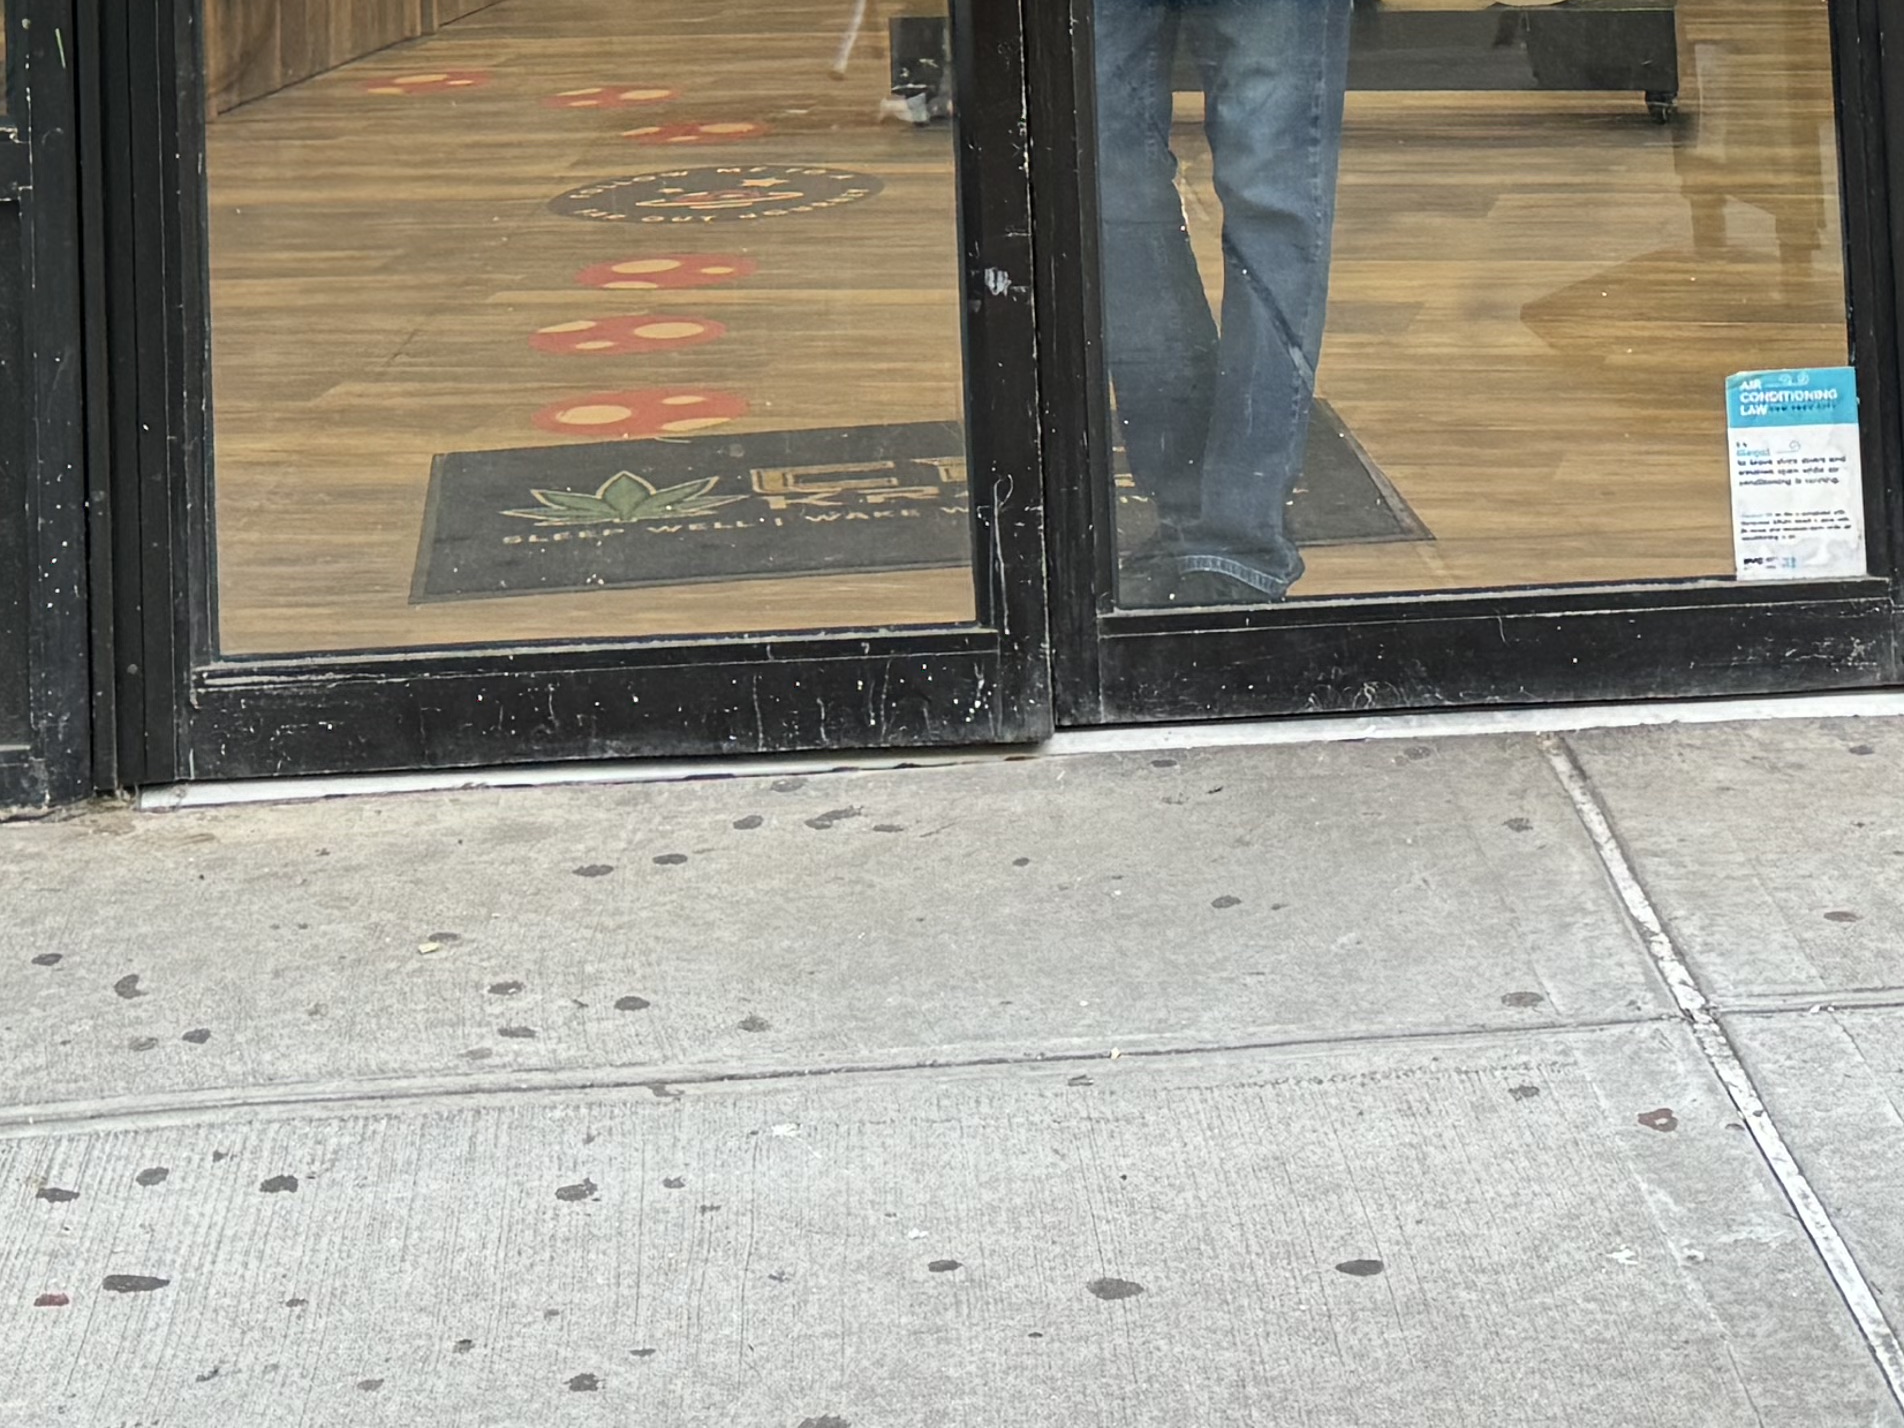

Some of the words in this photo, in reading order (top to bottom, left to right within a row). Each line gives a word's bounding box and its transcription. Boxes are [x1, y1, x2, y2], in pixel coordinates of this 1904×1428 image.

[1739, 379, 1762, 391] AIR
[1739, 388, 1838, 403] CONDITIONING
[1740, 404, 1769, 416] LAW
